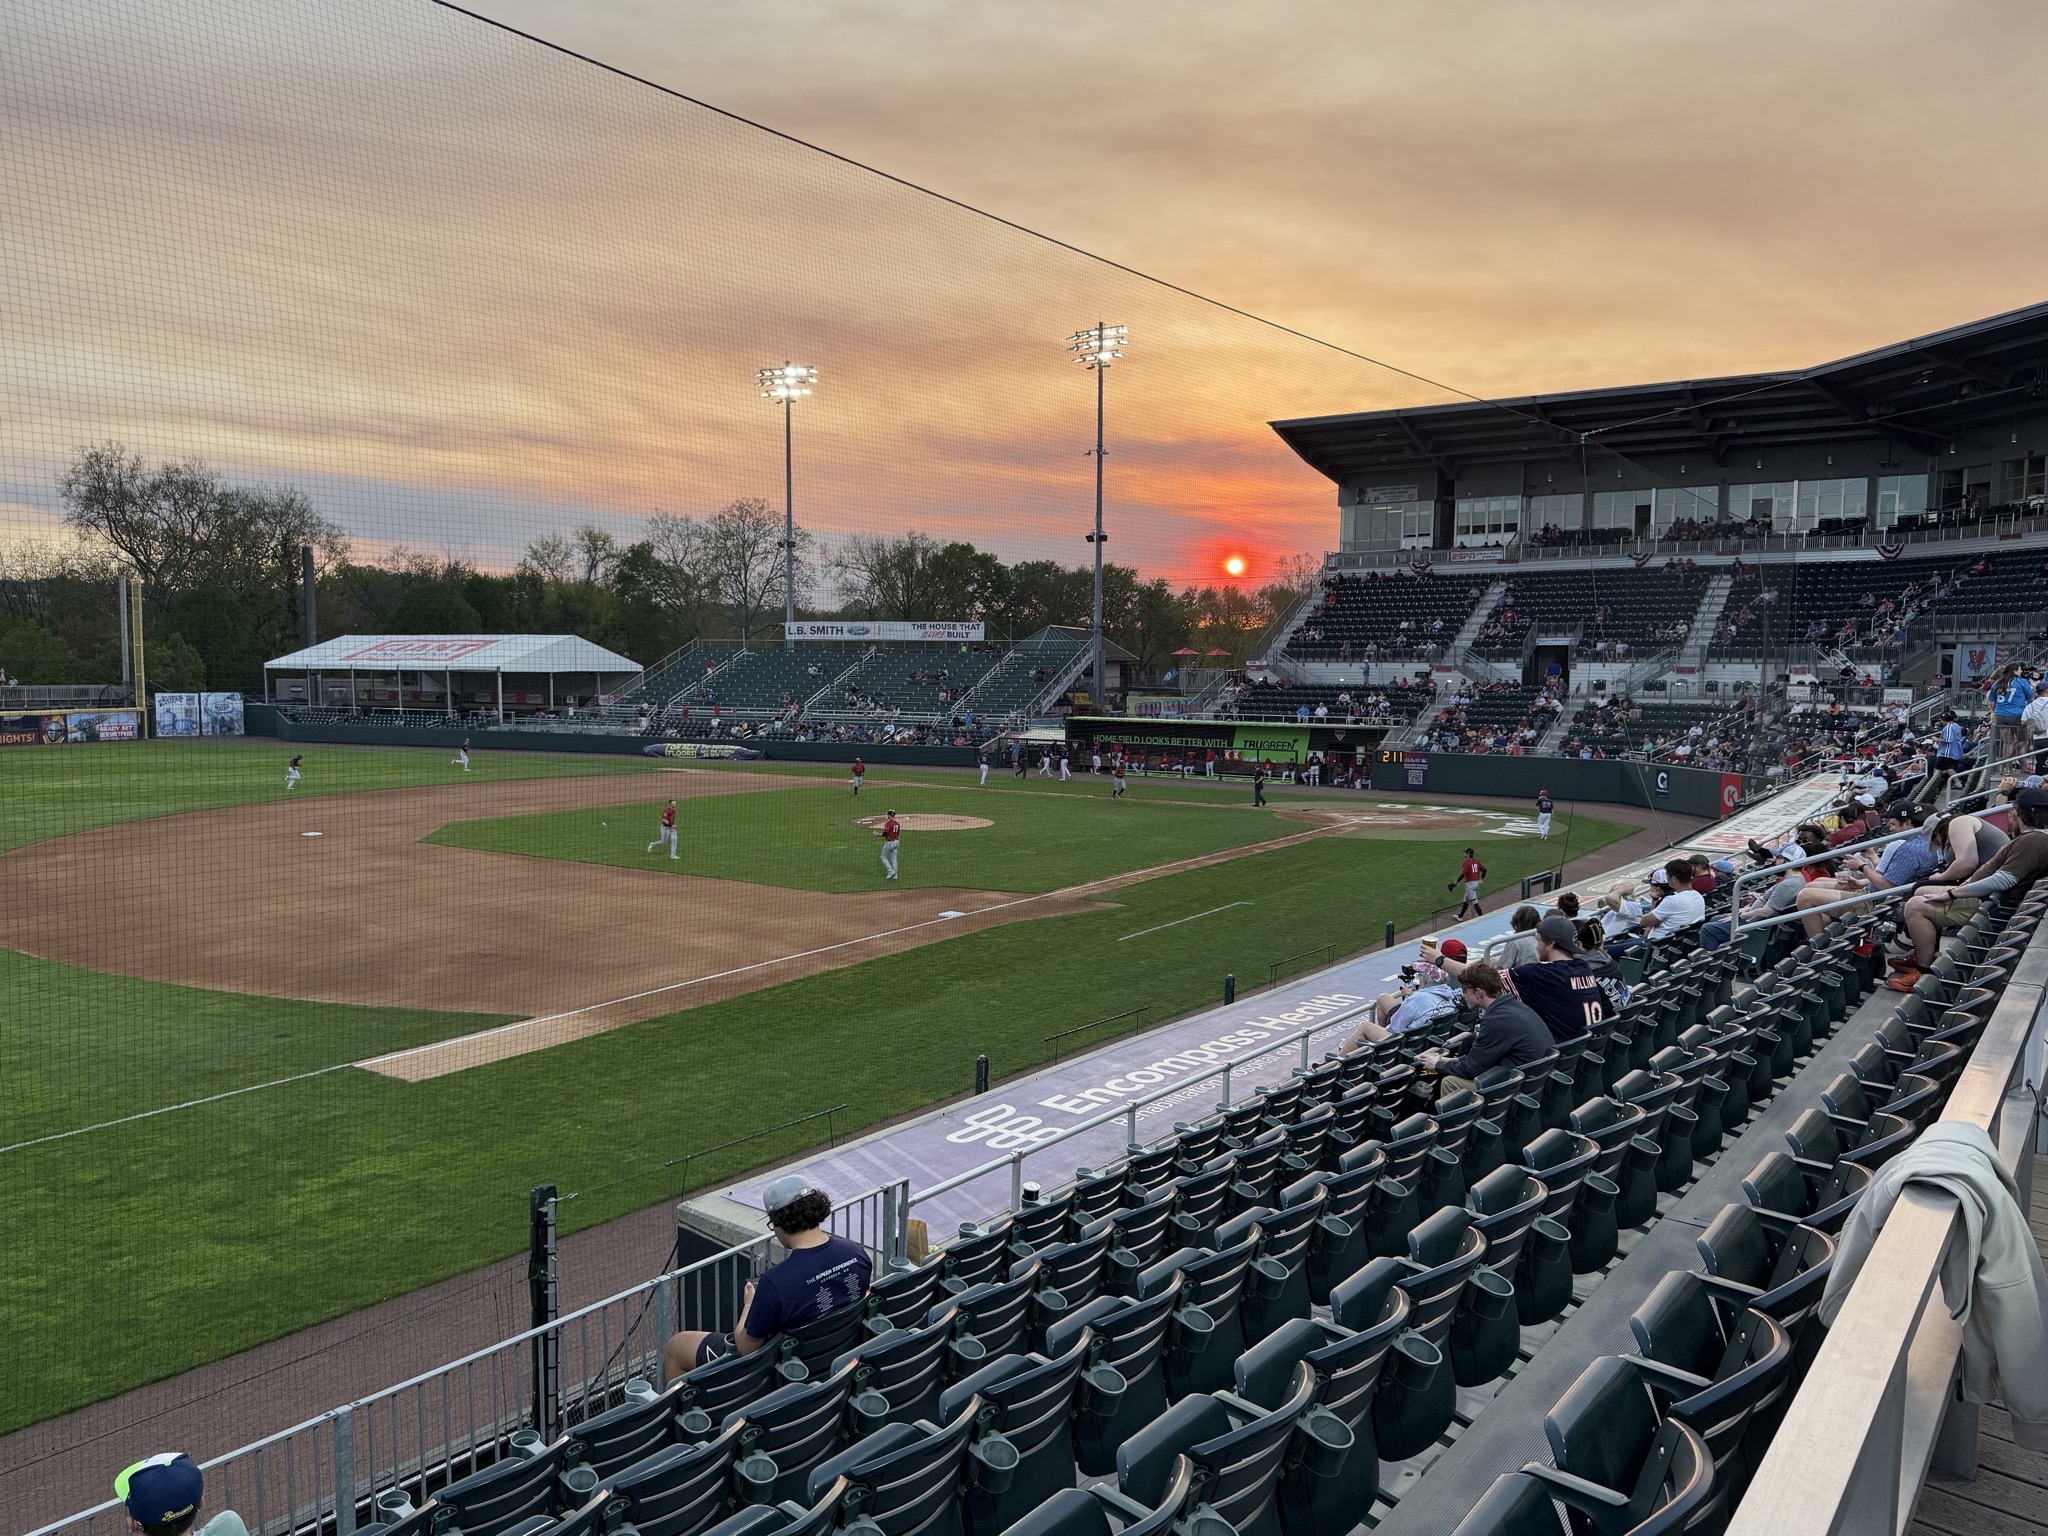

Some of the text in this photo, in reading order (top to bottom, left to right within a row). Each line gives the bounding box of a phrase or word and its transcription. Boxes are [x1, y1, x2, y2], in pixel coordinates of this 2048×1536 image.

[1451, 552, 1476, 560] ESPN
[788, 626, 844, 635] L.B. SMITH
[929, 623, 957, 631] HOUSE
[959, 623, 981, 631] THAT
[947, 631, 970, 639] BUILT
[1141, 736, 1171, 745] LOOKS
[1172, 737, 1204, 746] BETTER
[1204, 738, 1228, 747] WITH
[1242, 739, 1295, 751] TRUGREEN
[1727, 790, 1735, 802] K
[1038, 991, 1364, 1115] Encompass Health
[1276, 1044, 1296, 1056] of
[806, 1257, 858, 1285] THE RIPKEN EXPERIENCE
